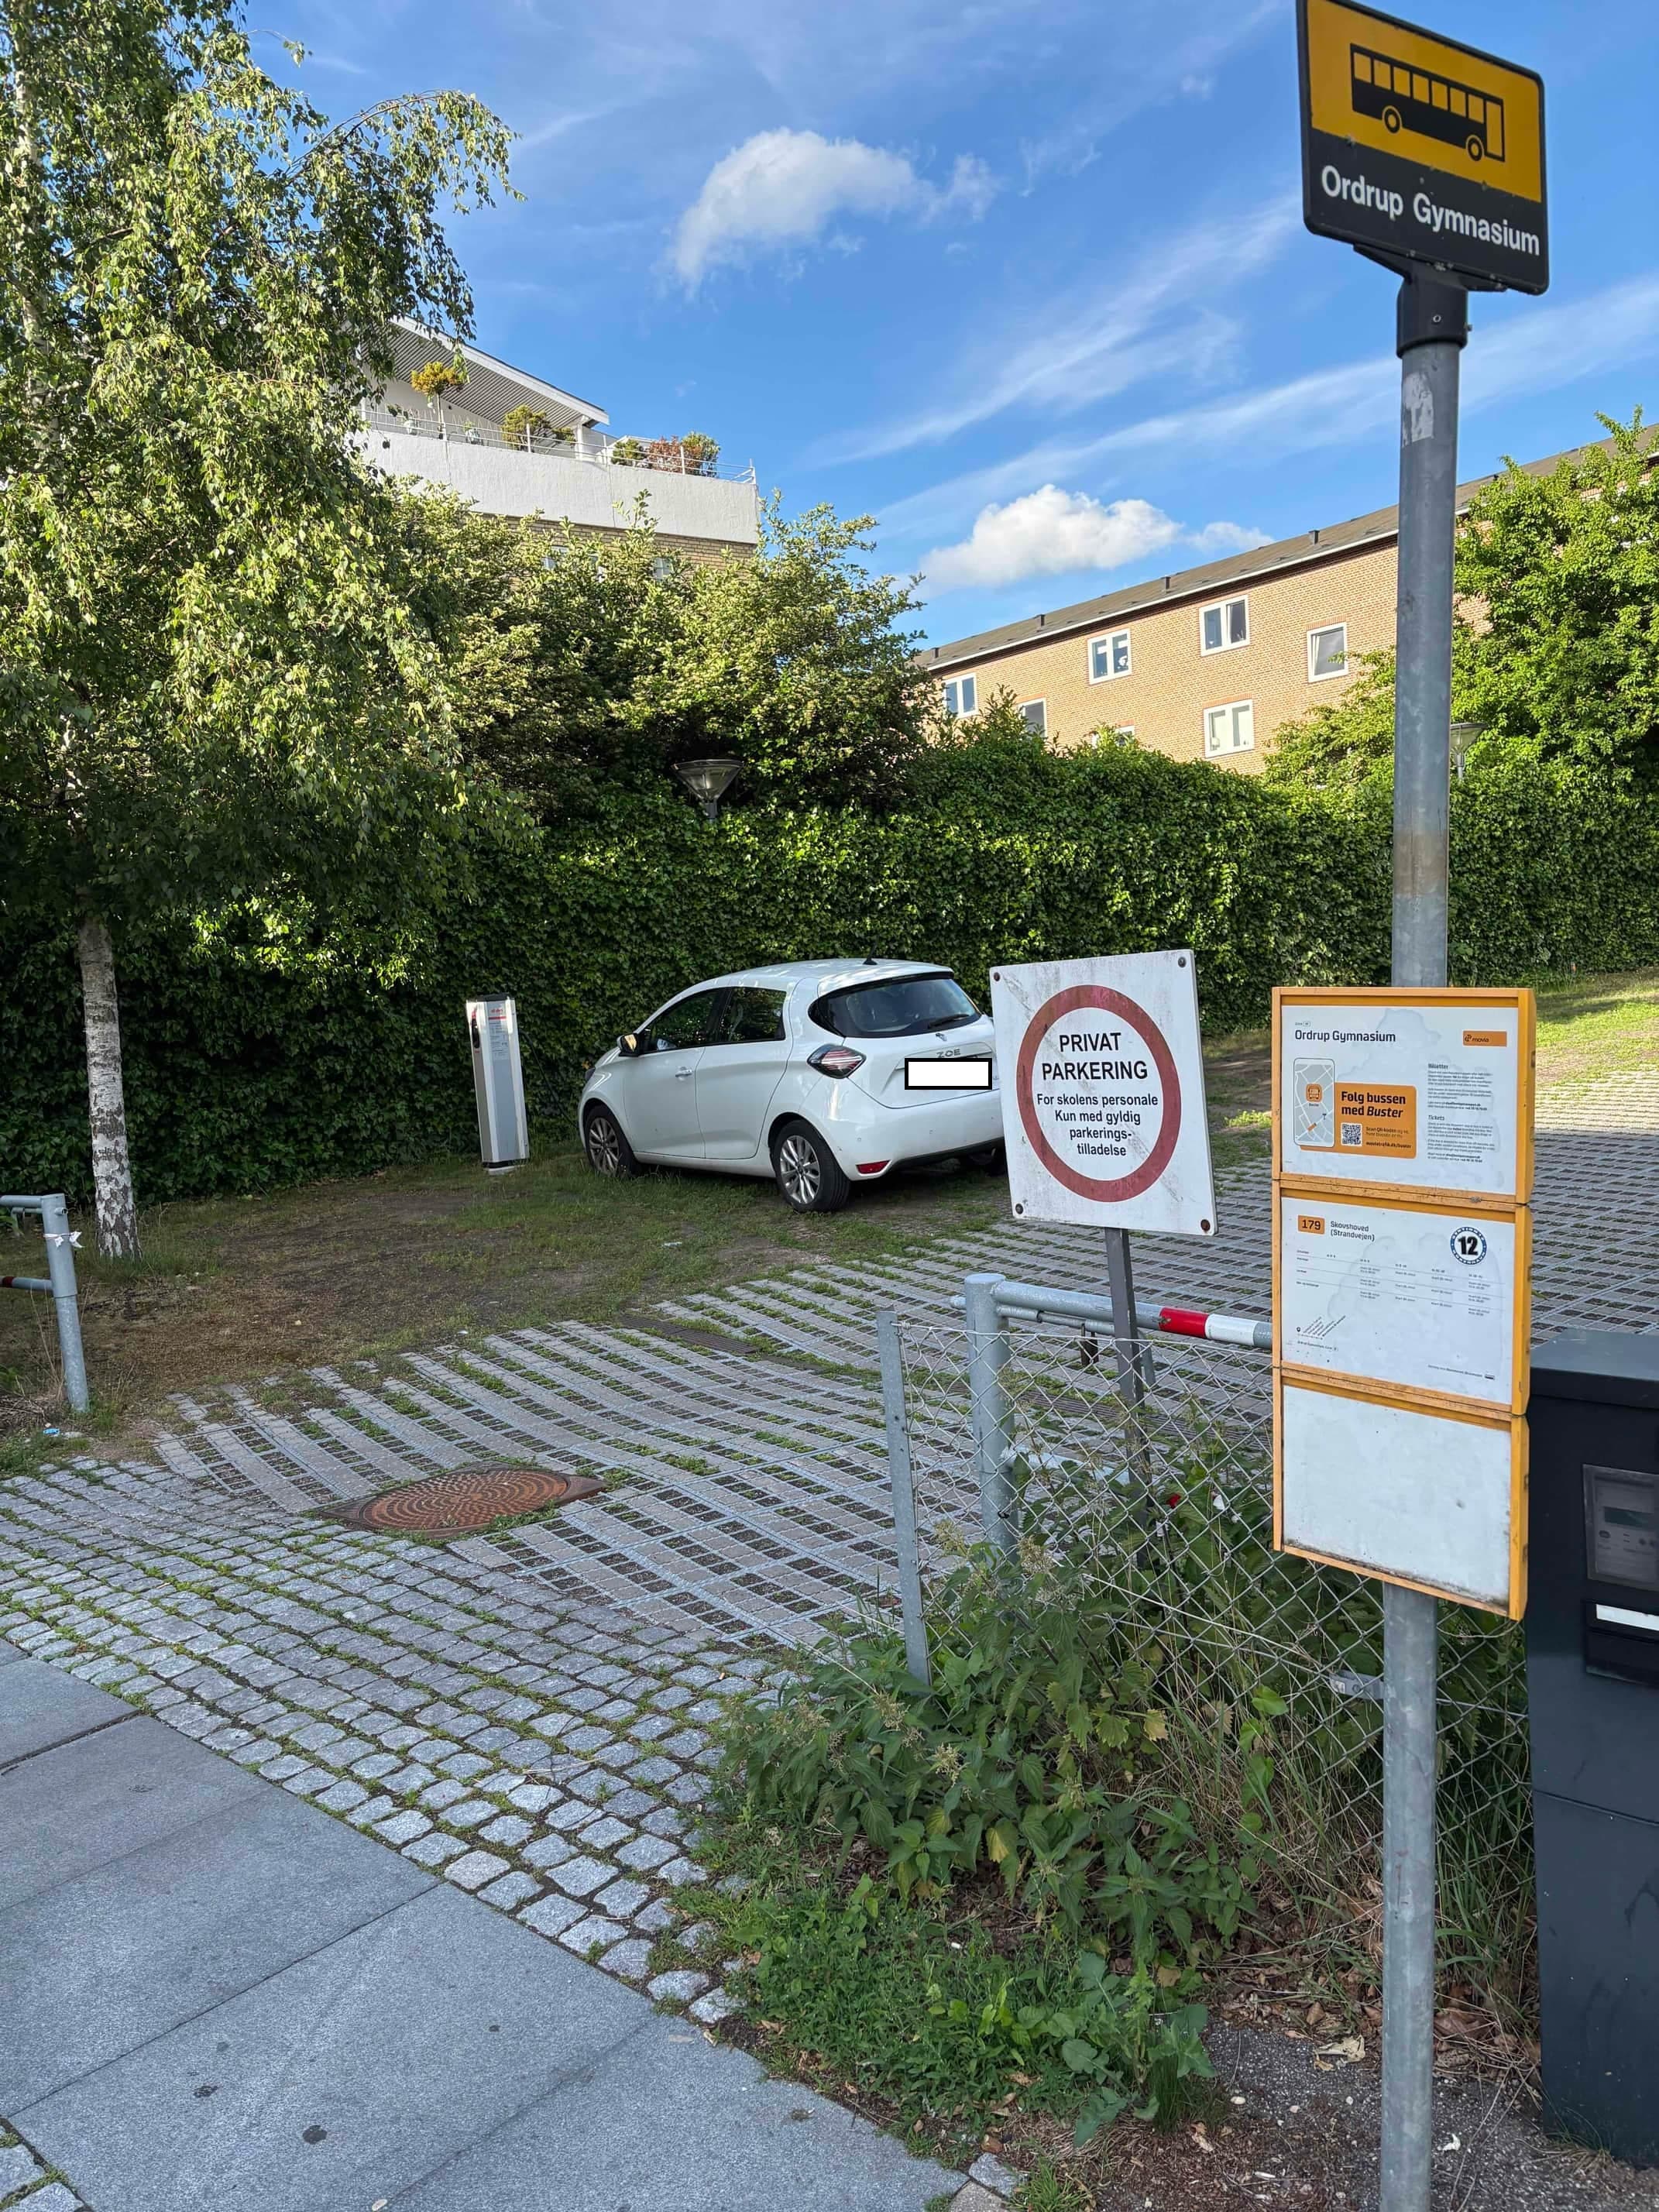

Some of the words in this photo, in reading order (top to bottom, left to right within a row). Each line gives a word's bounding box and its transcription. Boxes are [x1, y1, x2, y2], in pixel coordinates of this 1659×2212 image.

[1321, 165, 1404, 221] Ordrup
[1413, 192, 1540, 256] Gymnasium
[1059, 1032, 1121, 1053] PRIVAT
[1295, 1029, 1330, 1042] Ordrup
[1332, 1030, 1396, 1043] Gymnasium
[936, 1049, 961, 1058] ZOE
[1042, 1060, 1148, 1080] PARKERING
[1037, 1094, 1054, 1105] For
[1057, 1094, 1098, 1105] skolens
[1102, 1093, 1159, 1108] personale
[1341, 1091, 1365, 1104] Følg
[1367, 1092, 1406, 1104] bussen
[1055, 1110, 1077, 1121] Kun
[1080, 1111, 1103, 1122] med
[1105, 1111, 1141, 1125] gyldig
[1341, 1105, 1365, 1116] med
[1367, 1106, 1403, 1118] Buster
[1070, 1126, 1132, 1142] parkerings-
[1077, 1143, 1127, 1156] tilladelse
[1302, 1219, 1321, 1231] 179
[1331, 1221, 1369, 1232] Skovshoved
[1331, 1229, 1375, 1242] (Strandvejen)
[1458, 1236, 1479, 1255] 12
